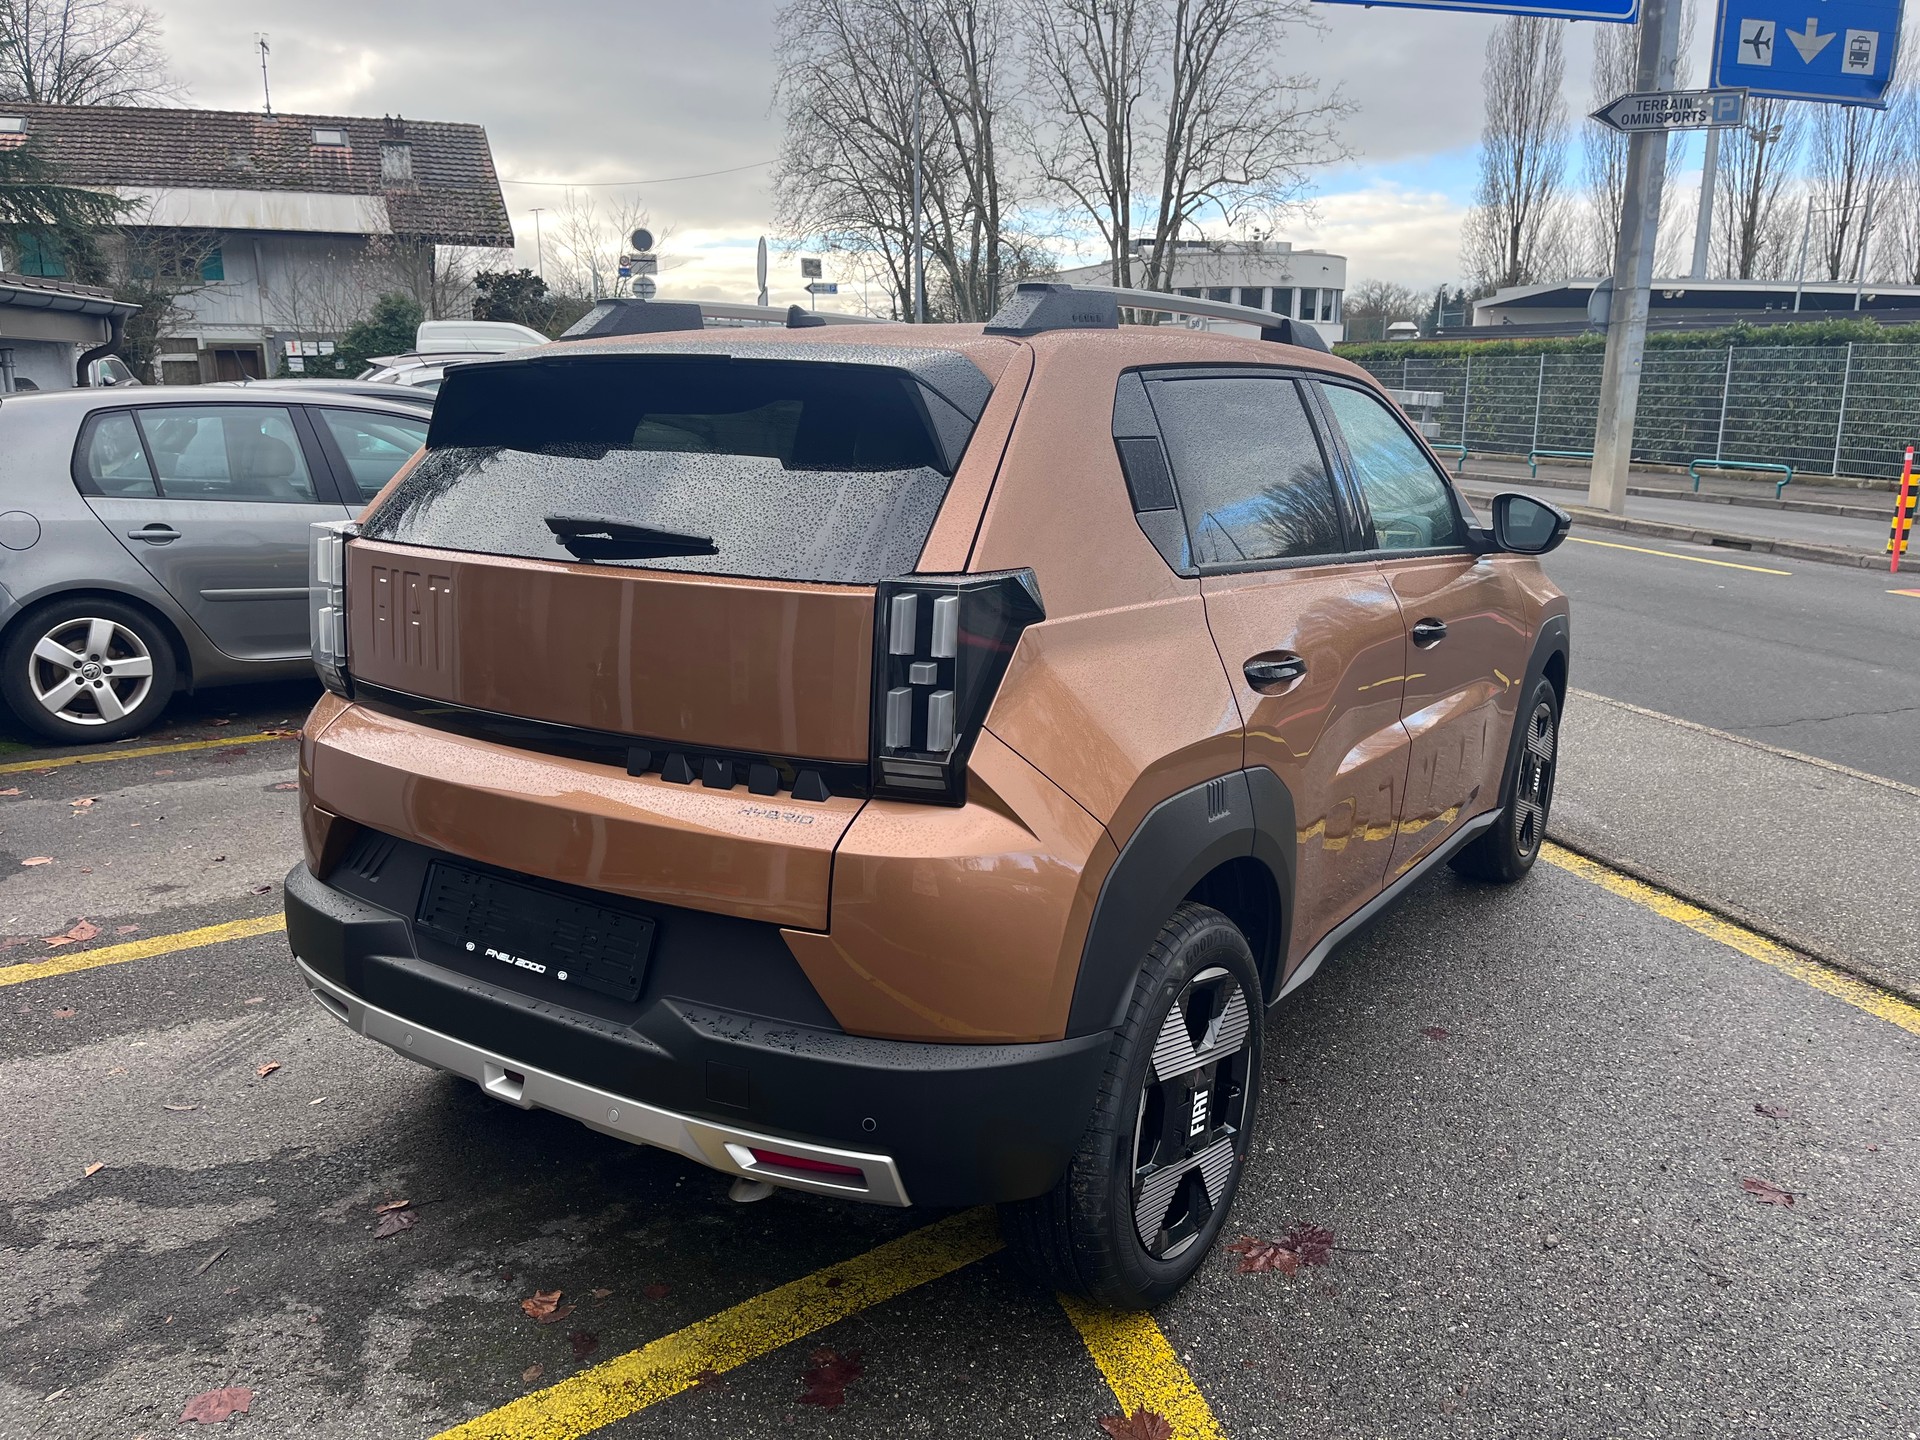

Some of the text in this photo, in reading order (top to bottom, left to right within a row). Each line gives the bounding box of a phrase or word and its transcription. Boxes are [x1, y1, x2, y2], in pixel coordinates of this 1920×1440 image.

[1636, 98, 1693, 111] TERRAIN
[1718, 99, 1734, 118] P
[1621, 110, 1707, 125] OMNISPORTS
[371, 565, 451, 672] FIAT
[627, 746, 832, 802] PANDA
[738, 807, 815, 824] HYBRID
[485, 948, 547, 974] PNEU 2000
[1190, 1090, 1209, 1137] FIAT
